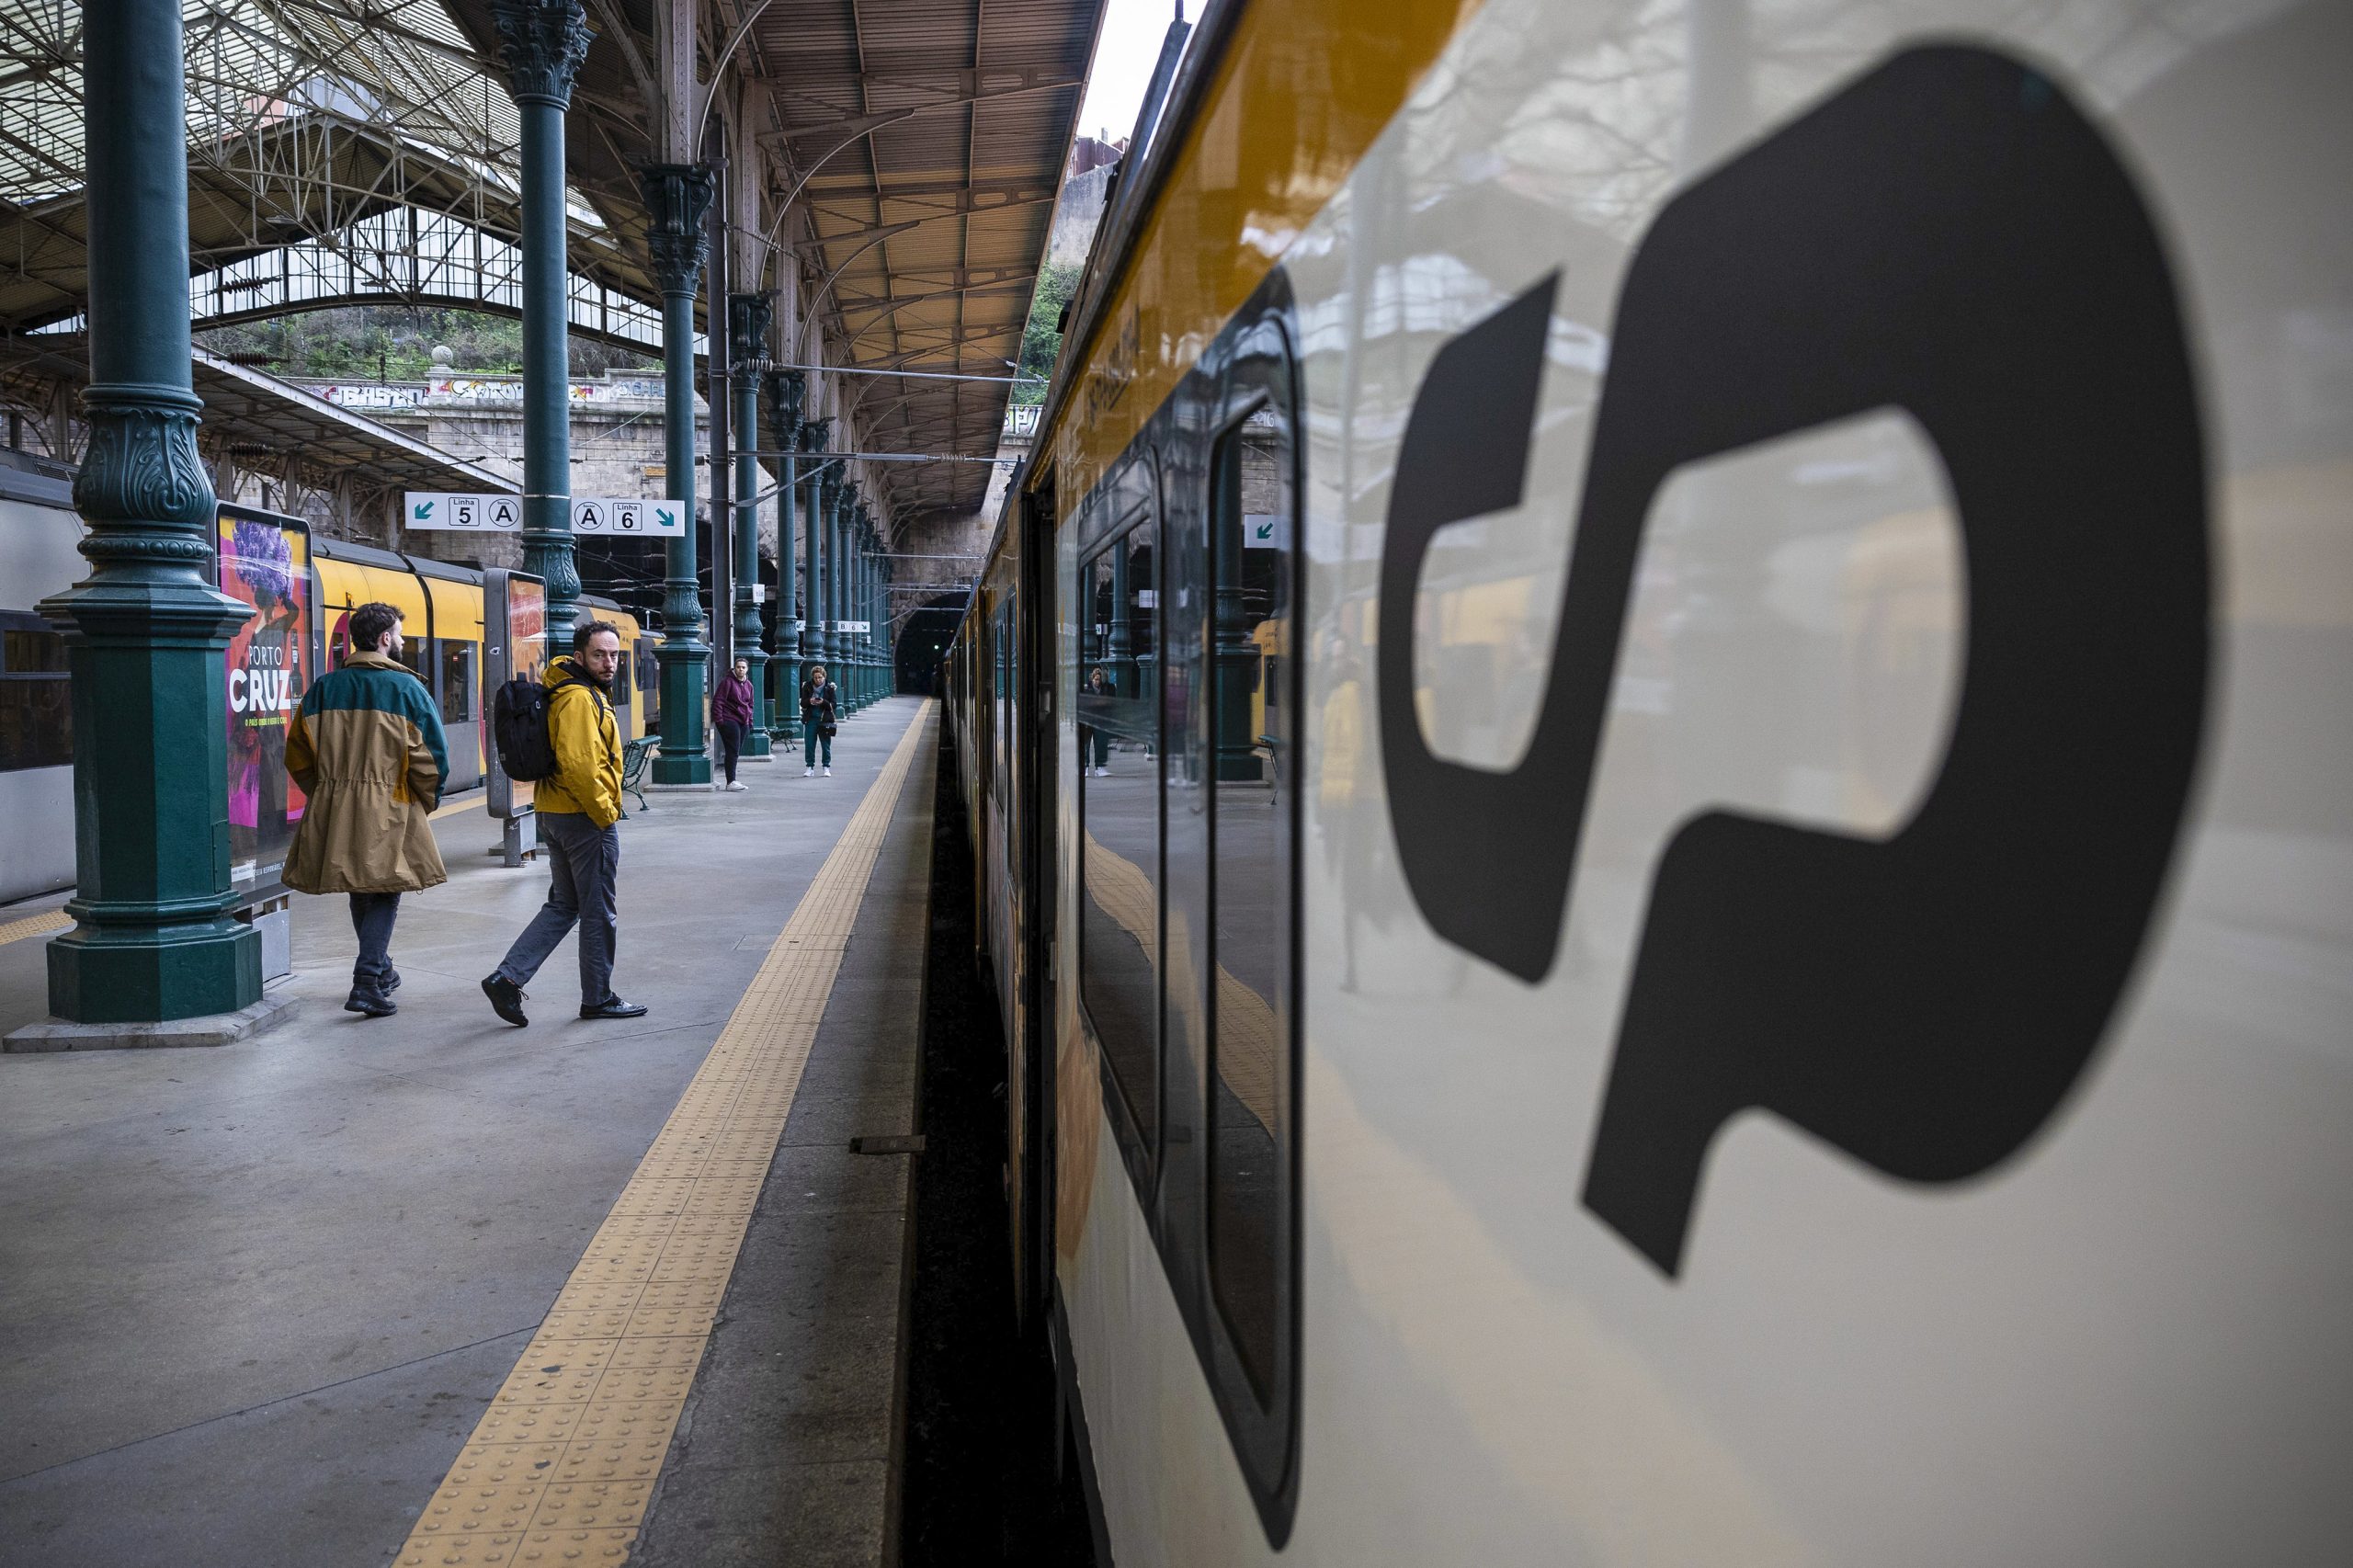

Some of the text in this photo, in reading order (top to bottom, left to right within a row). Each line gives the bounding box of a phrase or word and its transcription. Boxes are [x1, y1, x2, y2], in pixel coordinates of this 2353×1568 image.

[459, 506, 471, 524] 5
[495, 506, 513, 522] A
[581, 508, 597, 525] A
[621, 512, 633, 528] 6
[248, 645, 283, 666] PORTO
[229, 668, 291, 713] CRUZ
